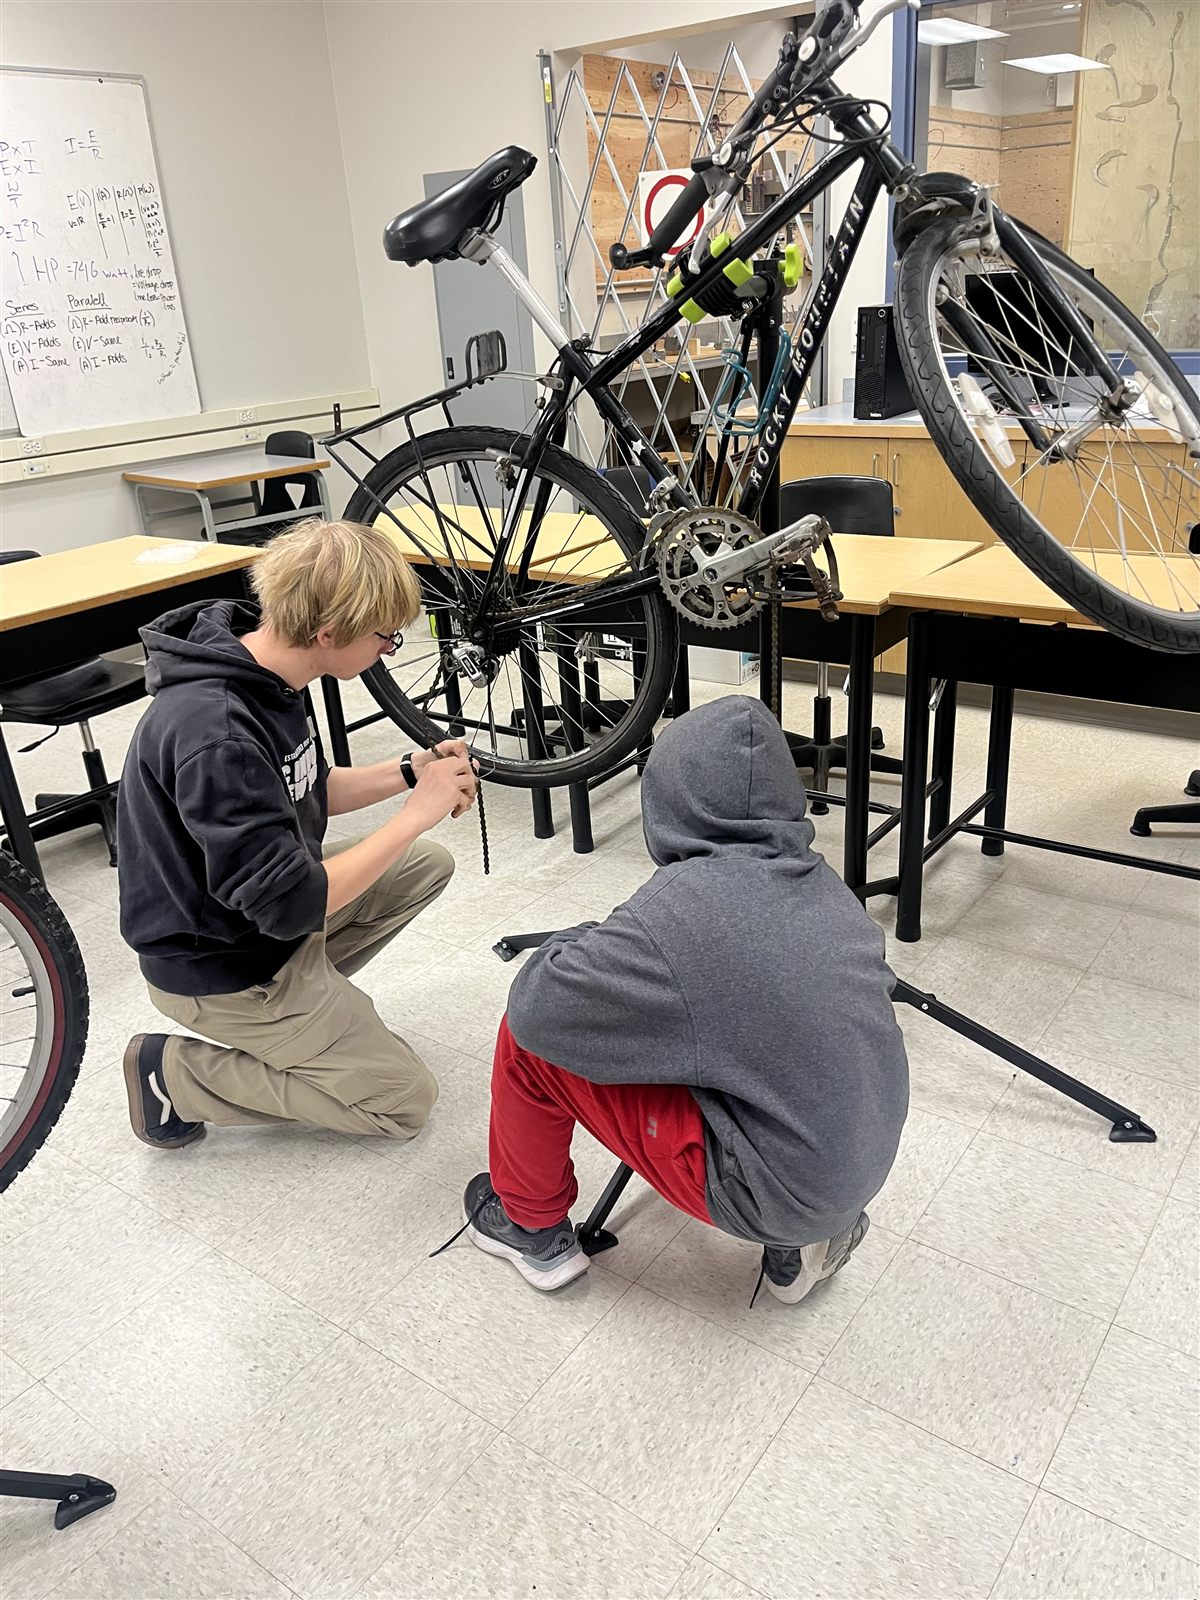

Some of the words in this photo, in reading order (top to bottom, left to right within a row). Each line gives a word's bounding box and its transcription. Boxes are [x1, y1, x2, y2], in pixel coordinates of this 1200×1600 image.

[33, 255, 59, 283] HP
[5, 299, 39, 316] Series
[750, 385, 792, 490] ROCKY
